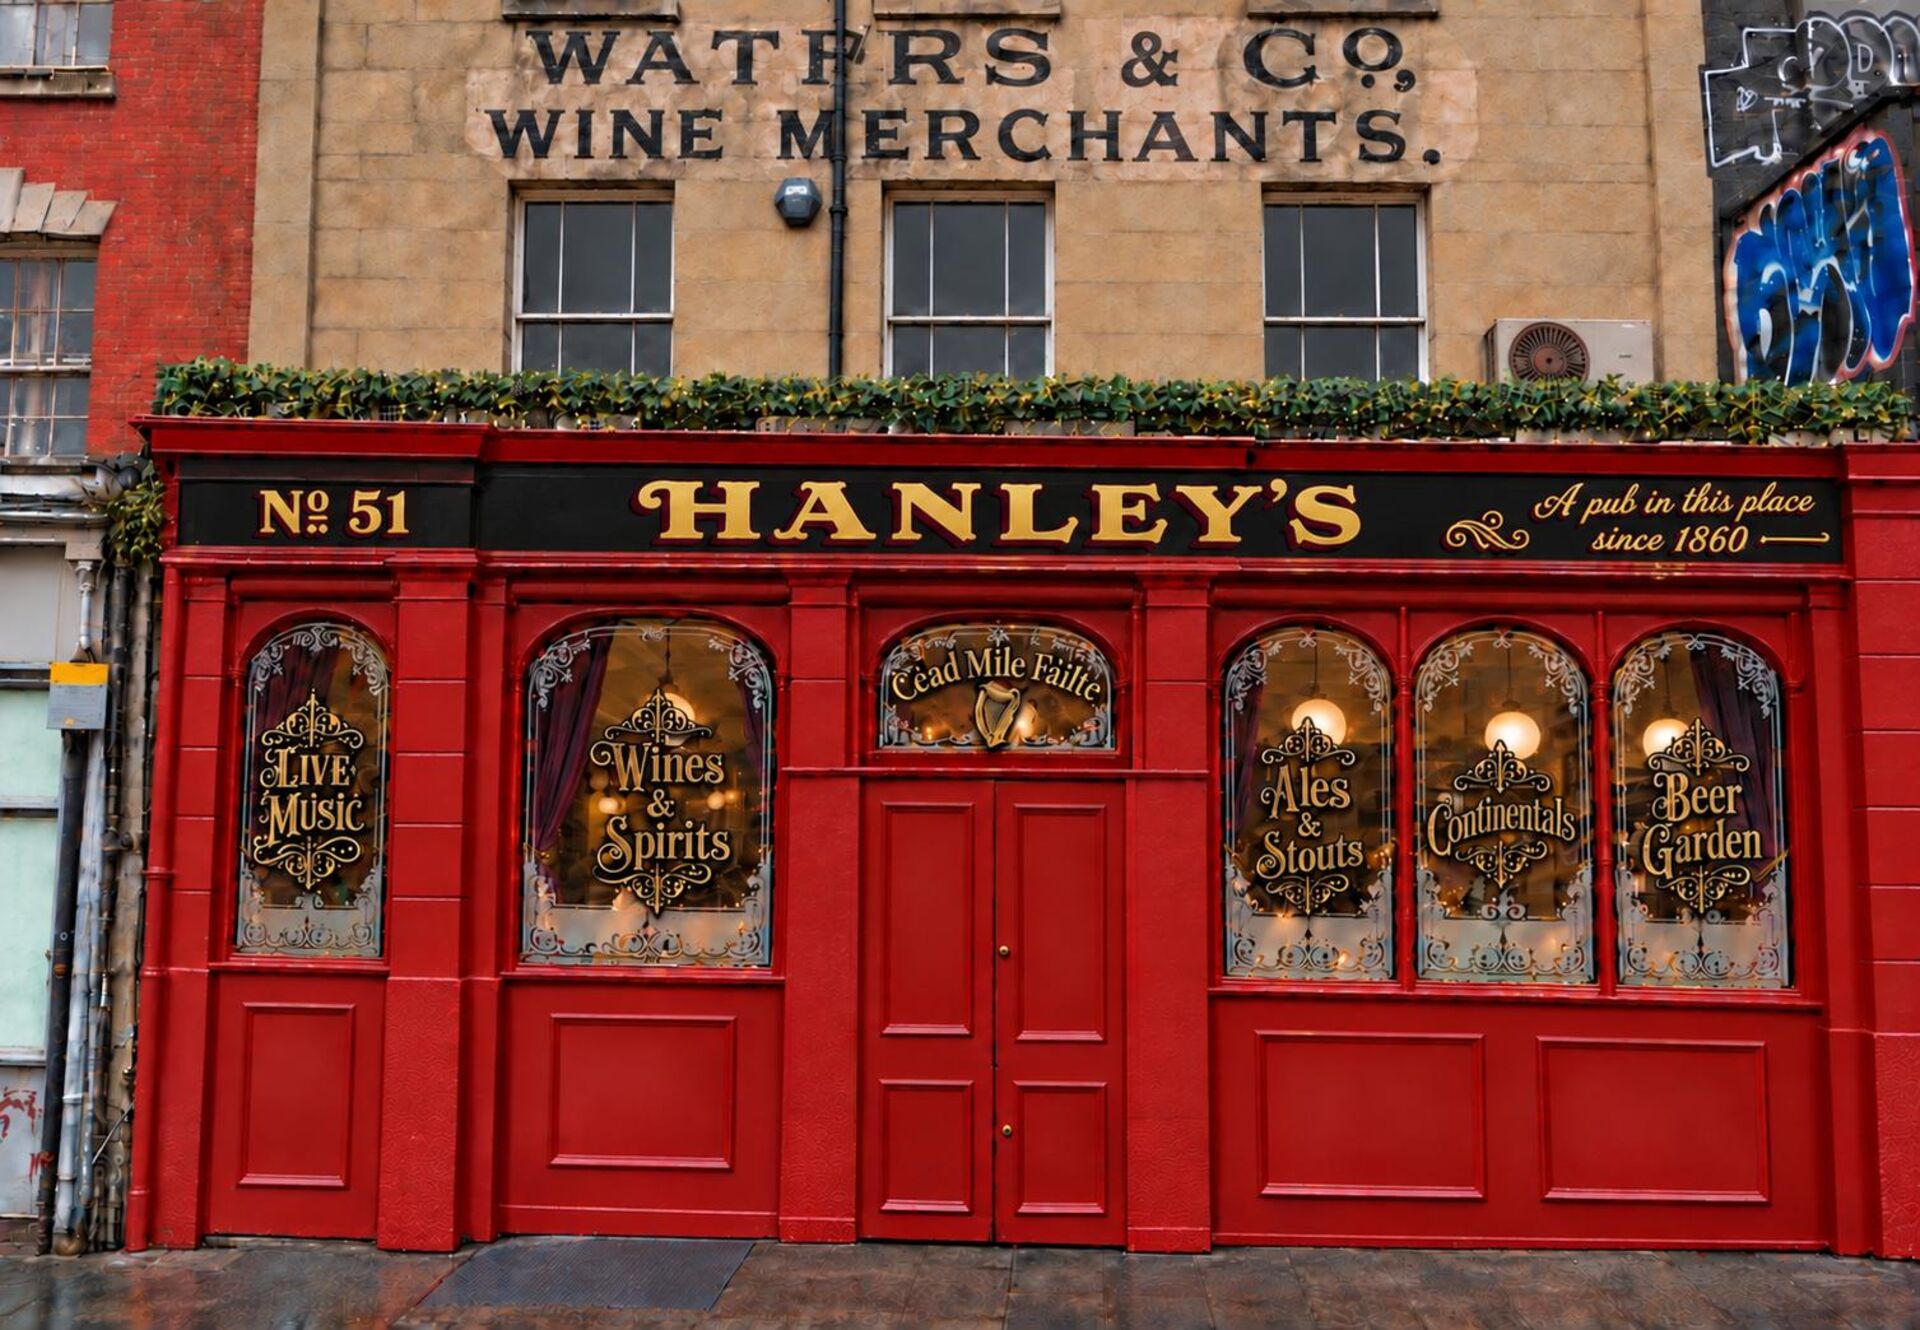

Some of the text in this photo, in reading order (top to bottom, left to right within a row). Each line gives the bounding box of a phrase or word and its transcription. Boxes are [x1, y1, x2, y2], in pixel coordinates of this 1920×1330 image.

[1121, 31, 1178, 88] &
[484, 107, 1442, 165] WINE MERCHANTS.
[349, 489, 410, 534] 51
[637, 476, 1362, 545] HANLEY'S
[1534, 481, 1816, 524] A pub in this place
[1591, 525, 1749, 553] since 1860
[590, 741, 725, 792] Wines
[1261, 764, 1351, 819] Ales
[647, 789, 675, 818] &
[1653, 772, 1743, 822] Beer
[597, 815, 731, 873] Spirits
[1298, 812, 1321, 837] &
[1427, 795, 1575, 856] Continentals
[1642, 818, 1763, 879] Garden
[1256, 833, 1363, 879] Stouts
